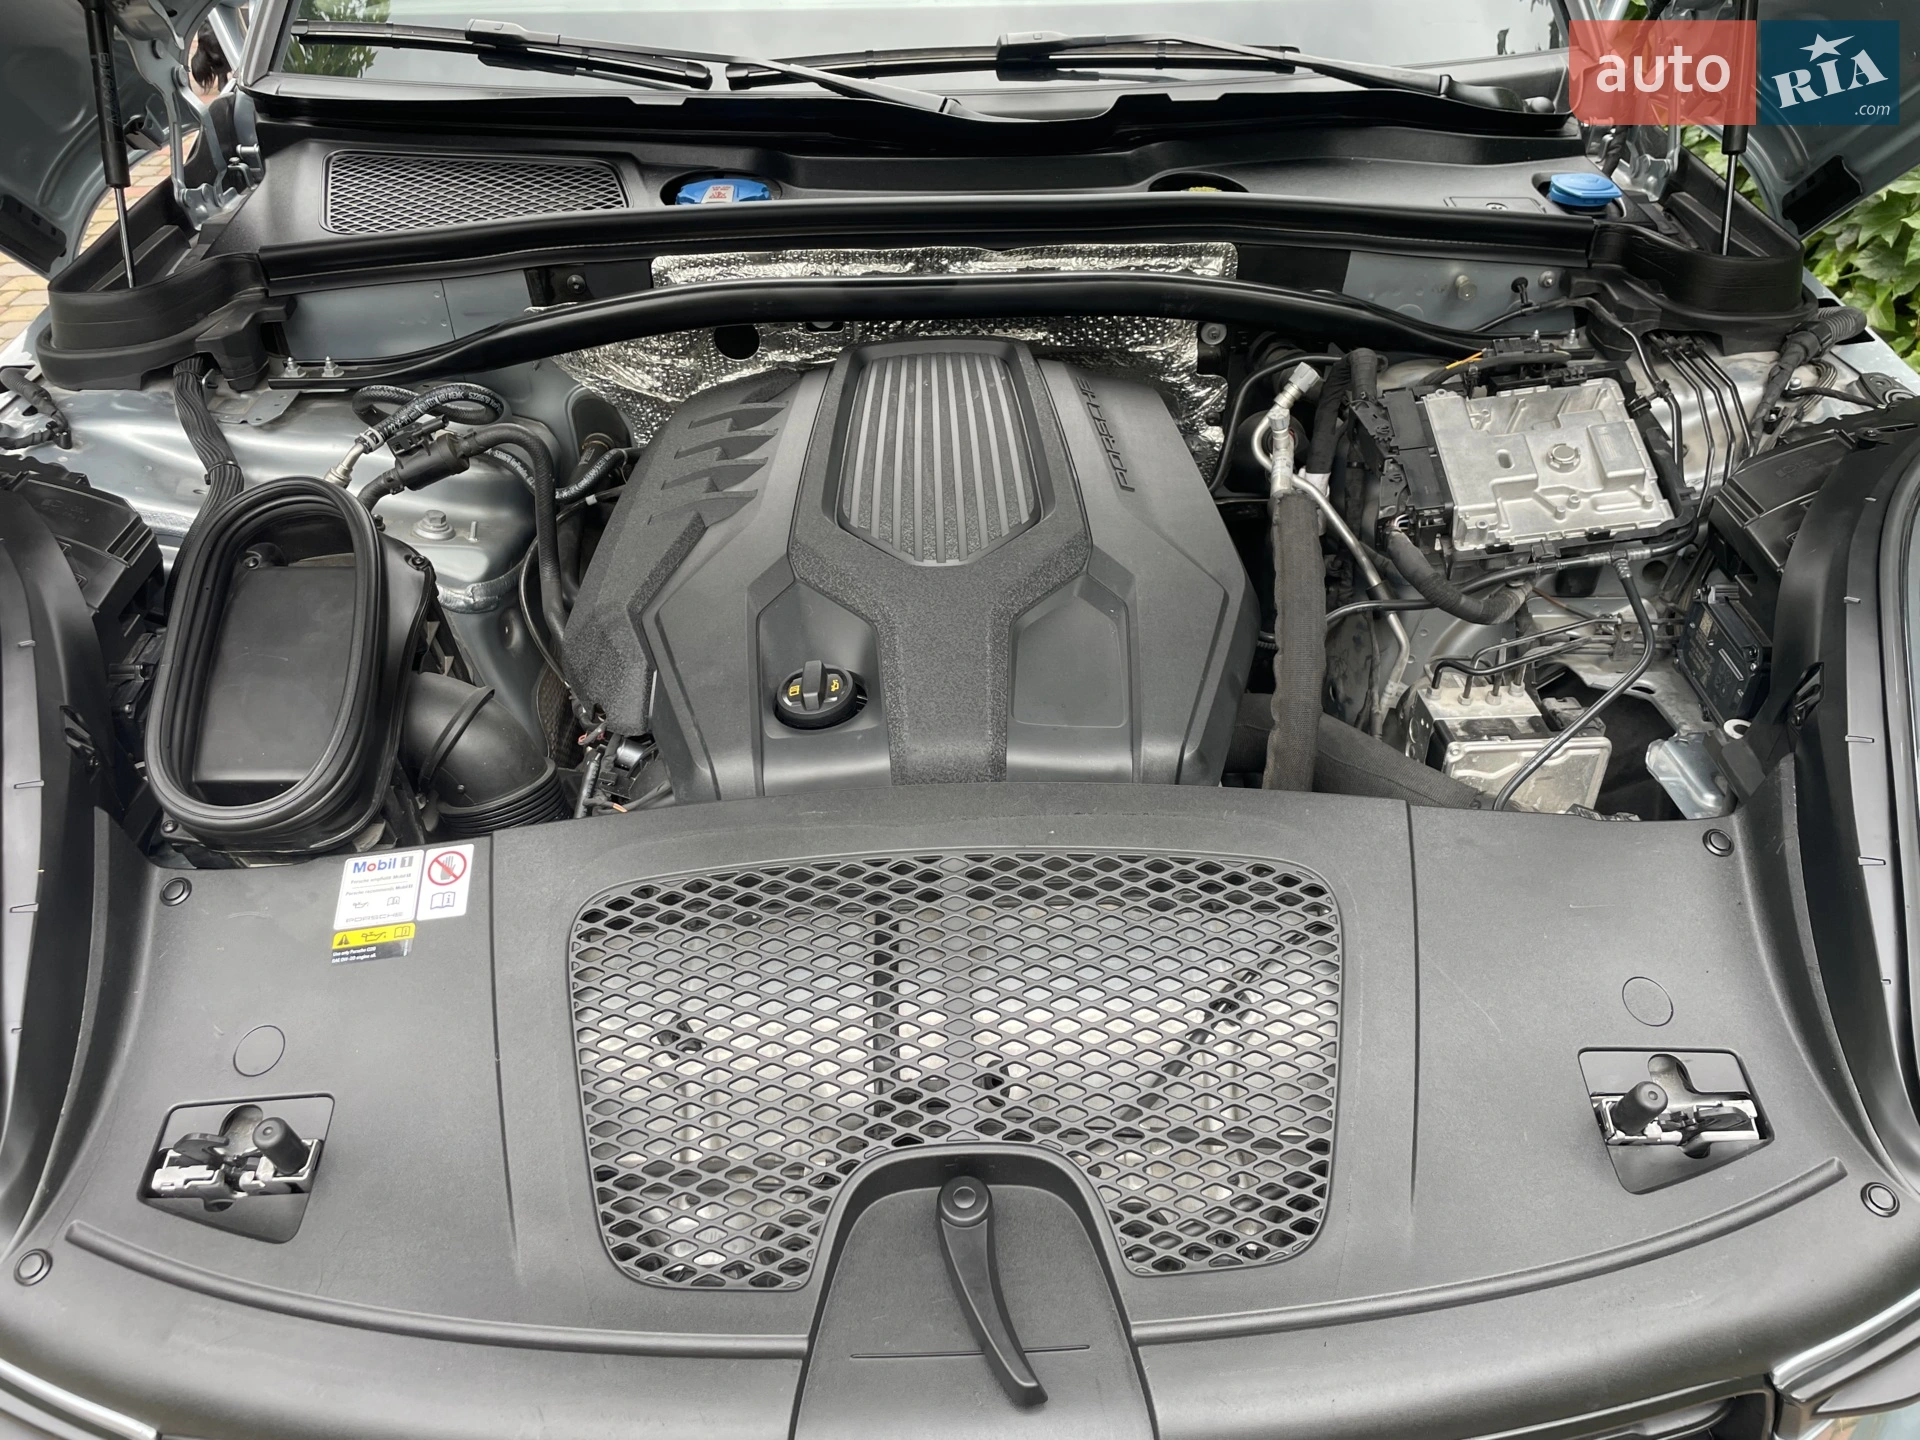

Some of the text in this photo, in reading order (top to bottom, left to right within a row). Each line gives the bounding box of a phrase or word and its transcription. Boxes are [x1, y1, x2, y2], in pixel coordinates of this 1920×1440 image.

[1076, 376, 1135, 493] PORSCHE
[352, 857, 397, 874] Mobil
[346, 912, 404, 923] PORSCHE
